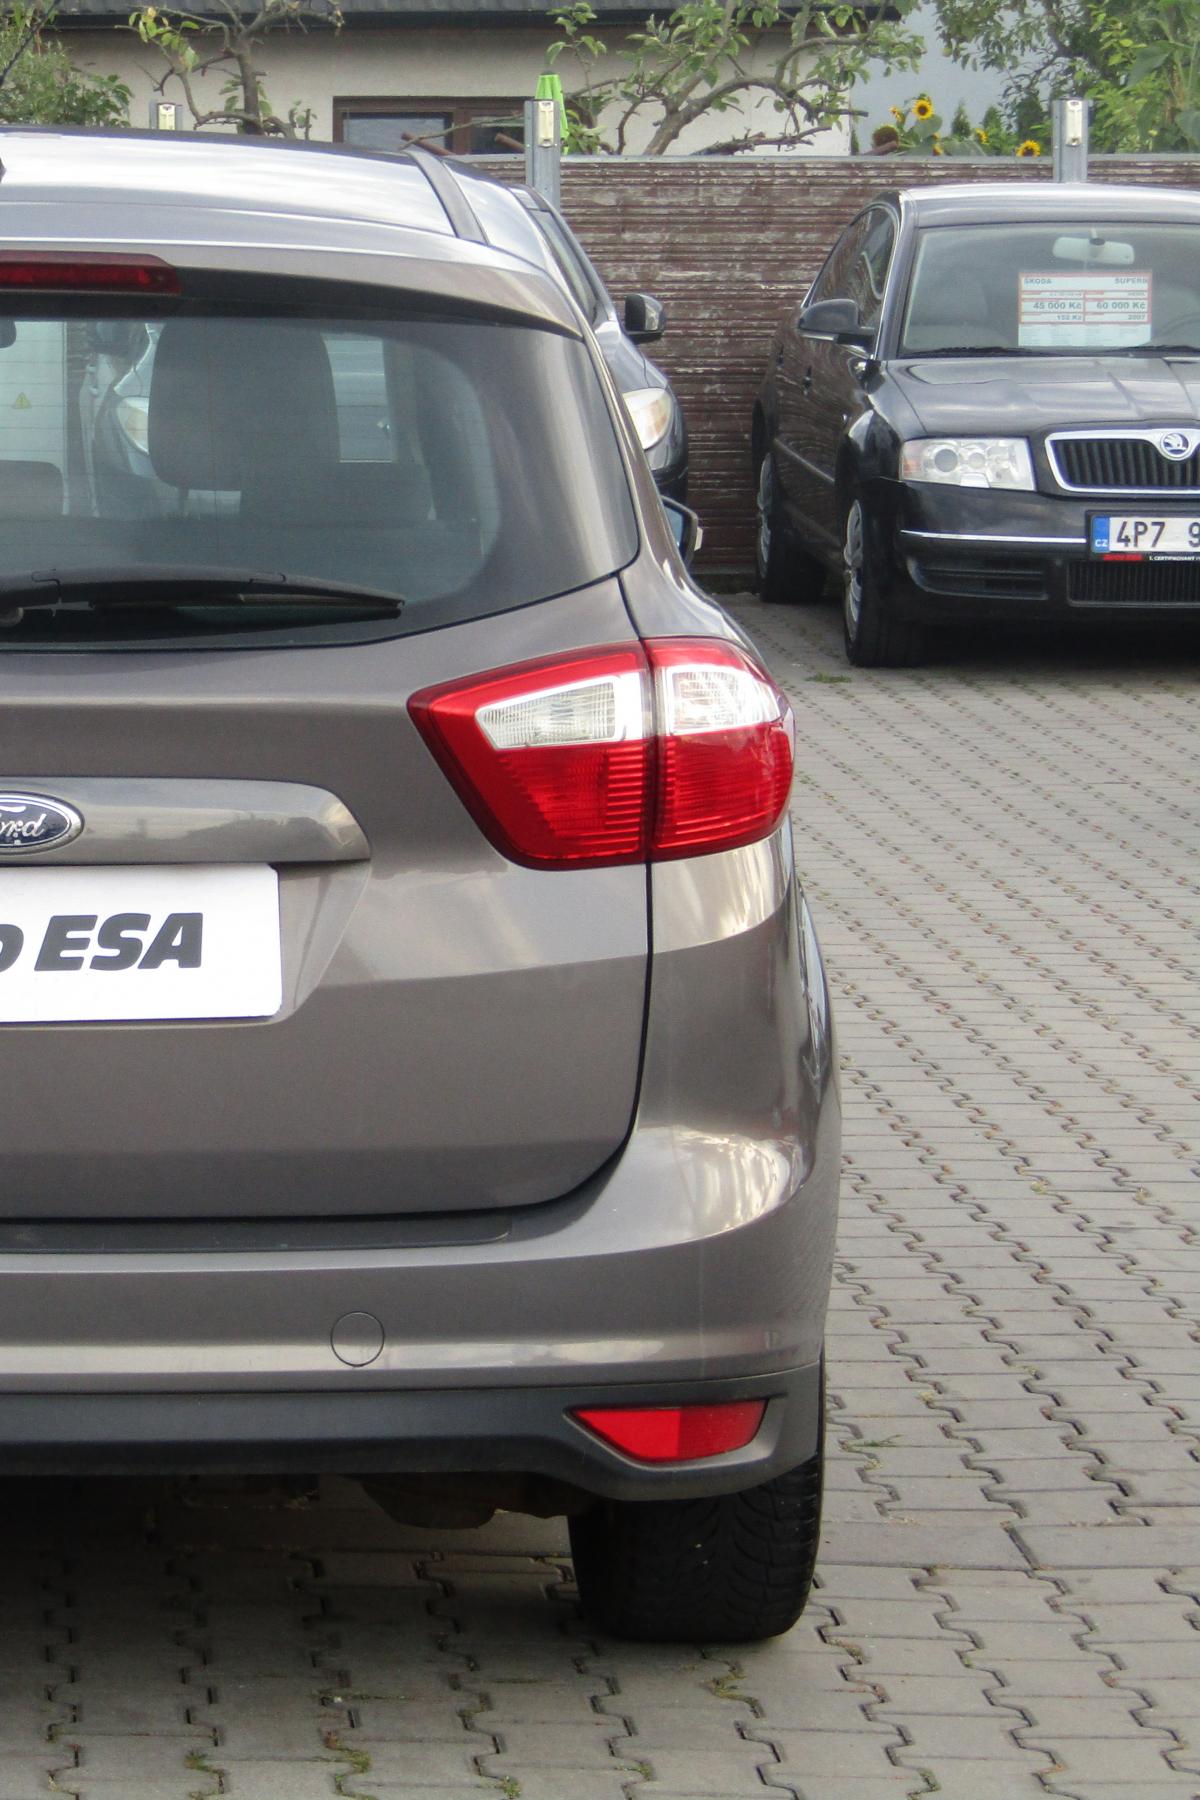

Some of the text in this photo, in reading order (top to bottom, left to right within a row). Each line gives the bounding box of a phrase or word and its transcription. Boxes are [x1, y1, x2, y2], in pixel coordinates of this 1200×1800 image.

[1047, 302, 1066, 310] 000
[1111, 302, 1130, 310] 000
[1116, 520, 1166, 548] 4P7
[1094, 539, 1108, 547] CZ
[33, 912, 204, 972] ESA
